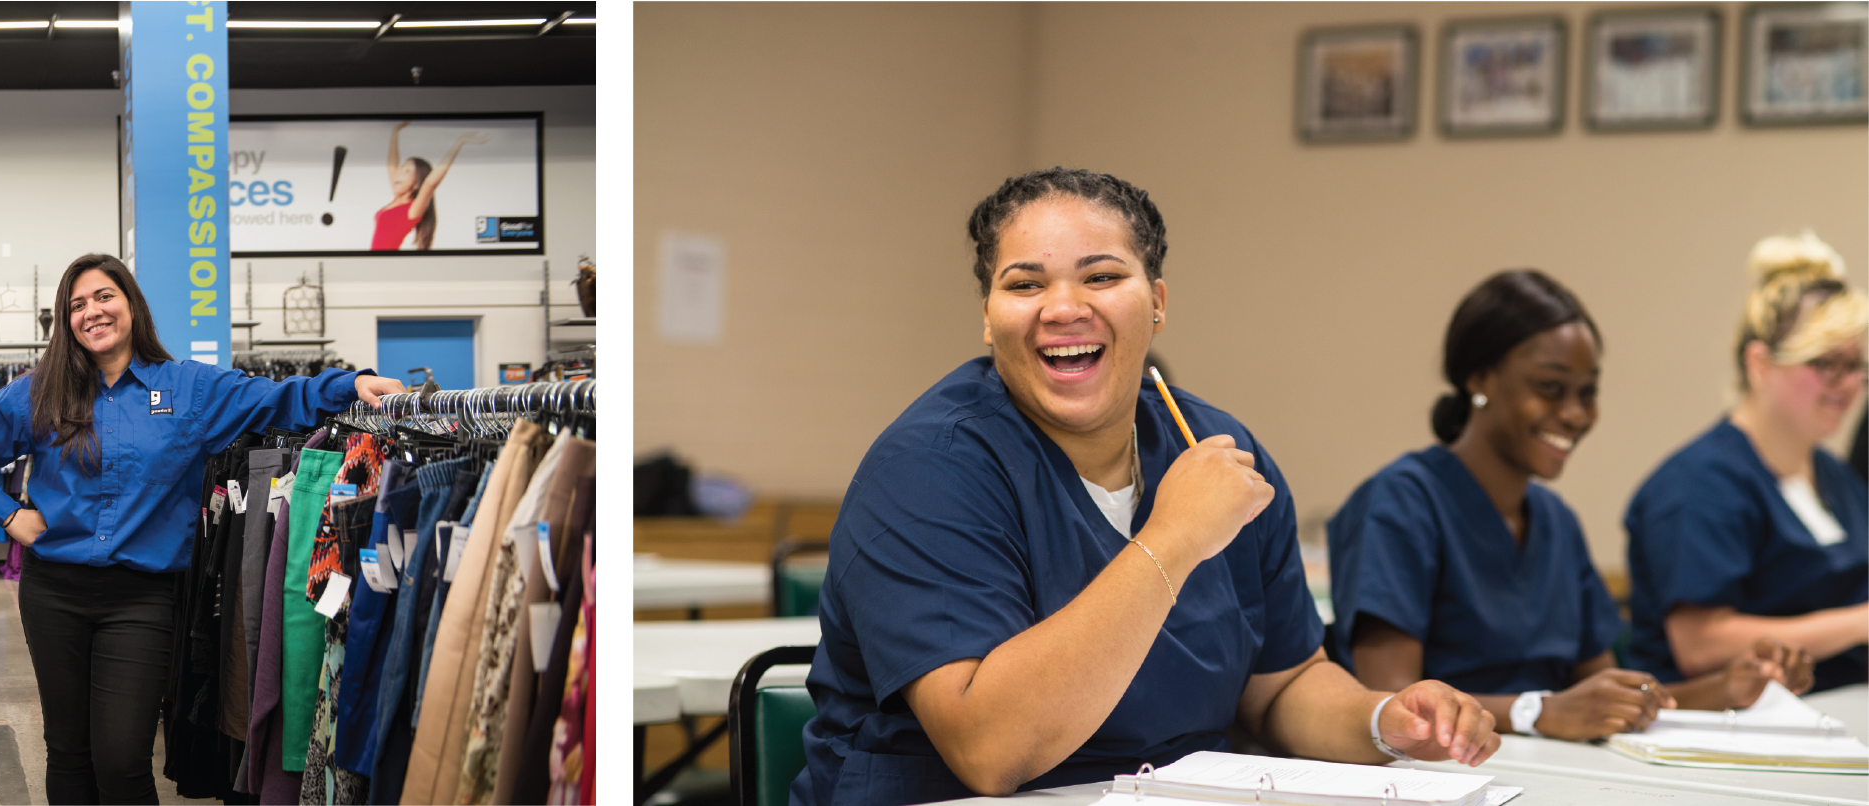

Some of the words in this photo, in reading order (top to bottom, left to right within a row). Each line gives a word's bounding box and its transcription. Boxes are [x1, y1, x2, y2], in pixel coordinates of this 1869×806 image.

[185, 0, 212, 41] T.
[229, 150, 267, 176] py
[186, 53, 218, 327] COMPASSION.
[230, 180, 294, 207] ces
[279, 211, 314, 226] here
